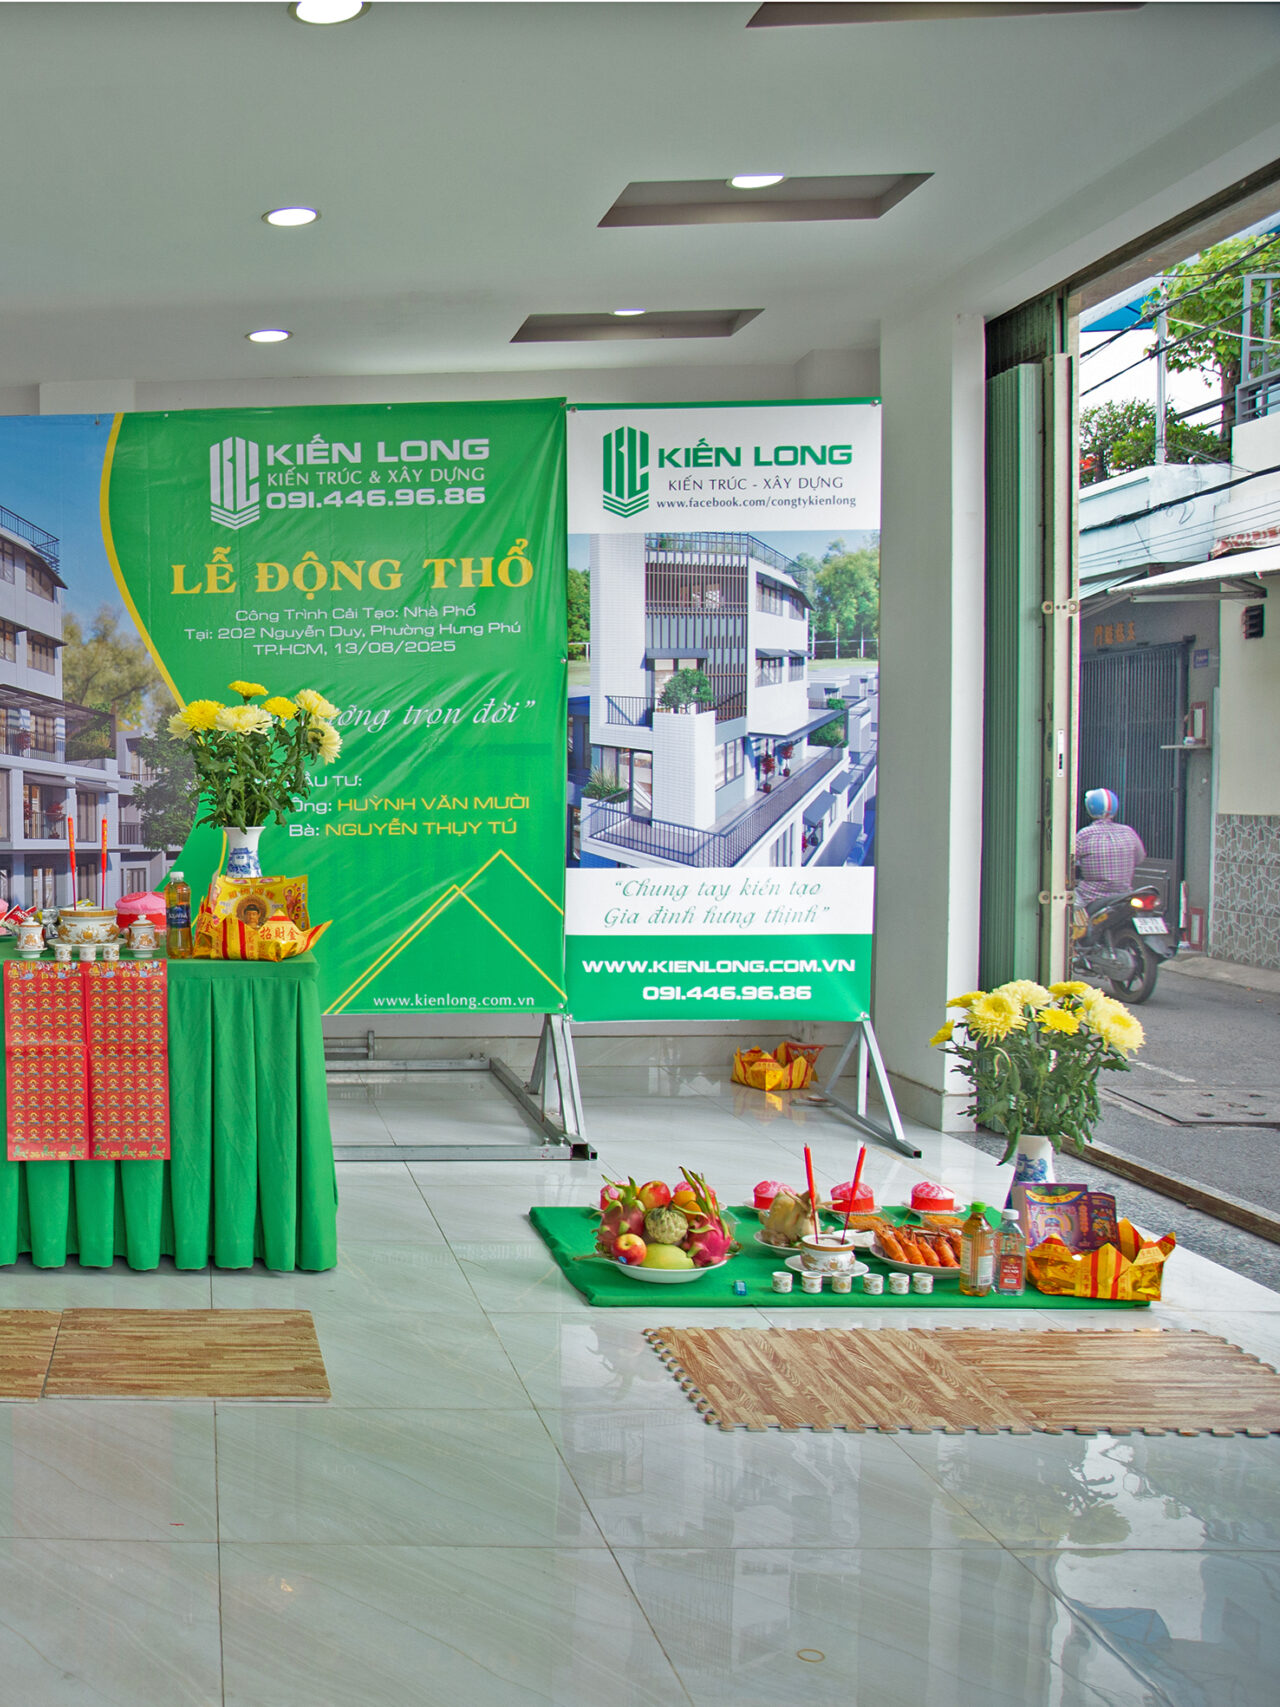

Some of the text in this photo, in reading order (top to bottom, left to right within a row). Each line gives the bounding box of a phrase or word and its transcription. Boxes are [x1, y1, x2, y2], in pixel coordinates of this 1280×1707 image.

[266, 433, 490, 466] KIẾN LONG
[658, 437, 853, 469] KIẾN LONG
[267, 465, 485, 487] KIẾN TRÚC & XÂY DỰNG
[668, 474, 703, 491] KIẾN
[708, 474, 747, 490] TRÚC
[763, 474, 792, 490] XÂY
[798, 474, 844, 491] DỰNG
[266, 486, 486, 509] 091.446.96.86
[656, 495, 856, 509] www.facebook.com/congtykienlong
[170, 538, 535, 600] LỄ ĐỘNG THỔ
[235, 602, 477, 623] Công Trình Cải Tạo: Nhà Phố
[183, 618, 521, 641] Tại: 202 Nguyễn Duy, Phường Hưng Phú
[253, 640, 456, 657] TP.HCM, 13/08/2025
[403, 704, 462, 728] trọn
[332, 774, 363, 788] TƯ:
[337, 794, 416, 811] HUỲNH
[420, 794, 468, 811] VĂN
[473, 792, 530, 810] MƯỜI
[289, 817, 518, 837] Bà: NGUYỄN THỤY TÚ
[697, 881, 732, 902] tay
[789, 880, 821, 898] tạo
[604, 907, 639, 928] Gia
[702, 905, 756, 929] hưng
[582, 958, 855, 974] WWW.KIENLONG.COM.VN
[373, 992, 535, 1010] www.kienlong.com.vn
[642, 985, 812, 1001] 091.446.96.86
